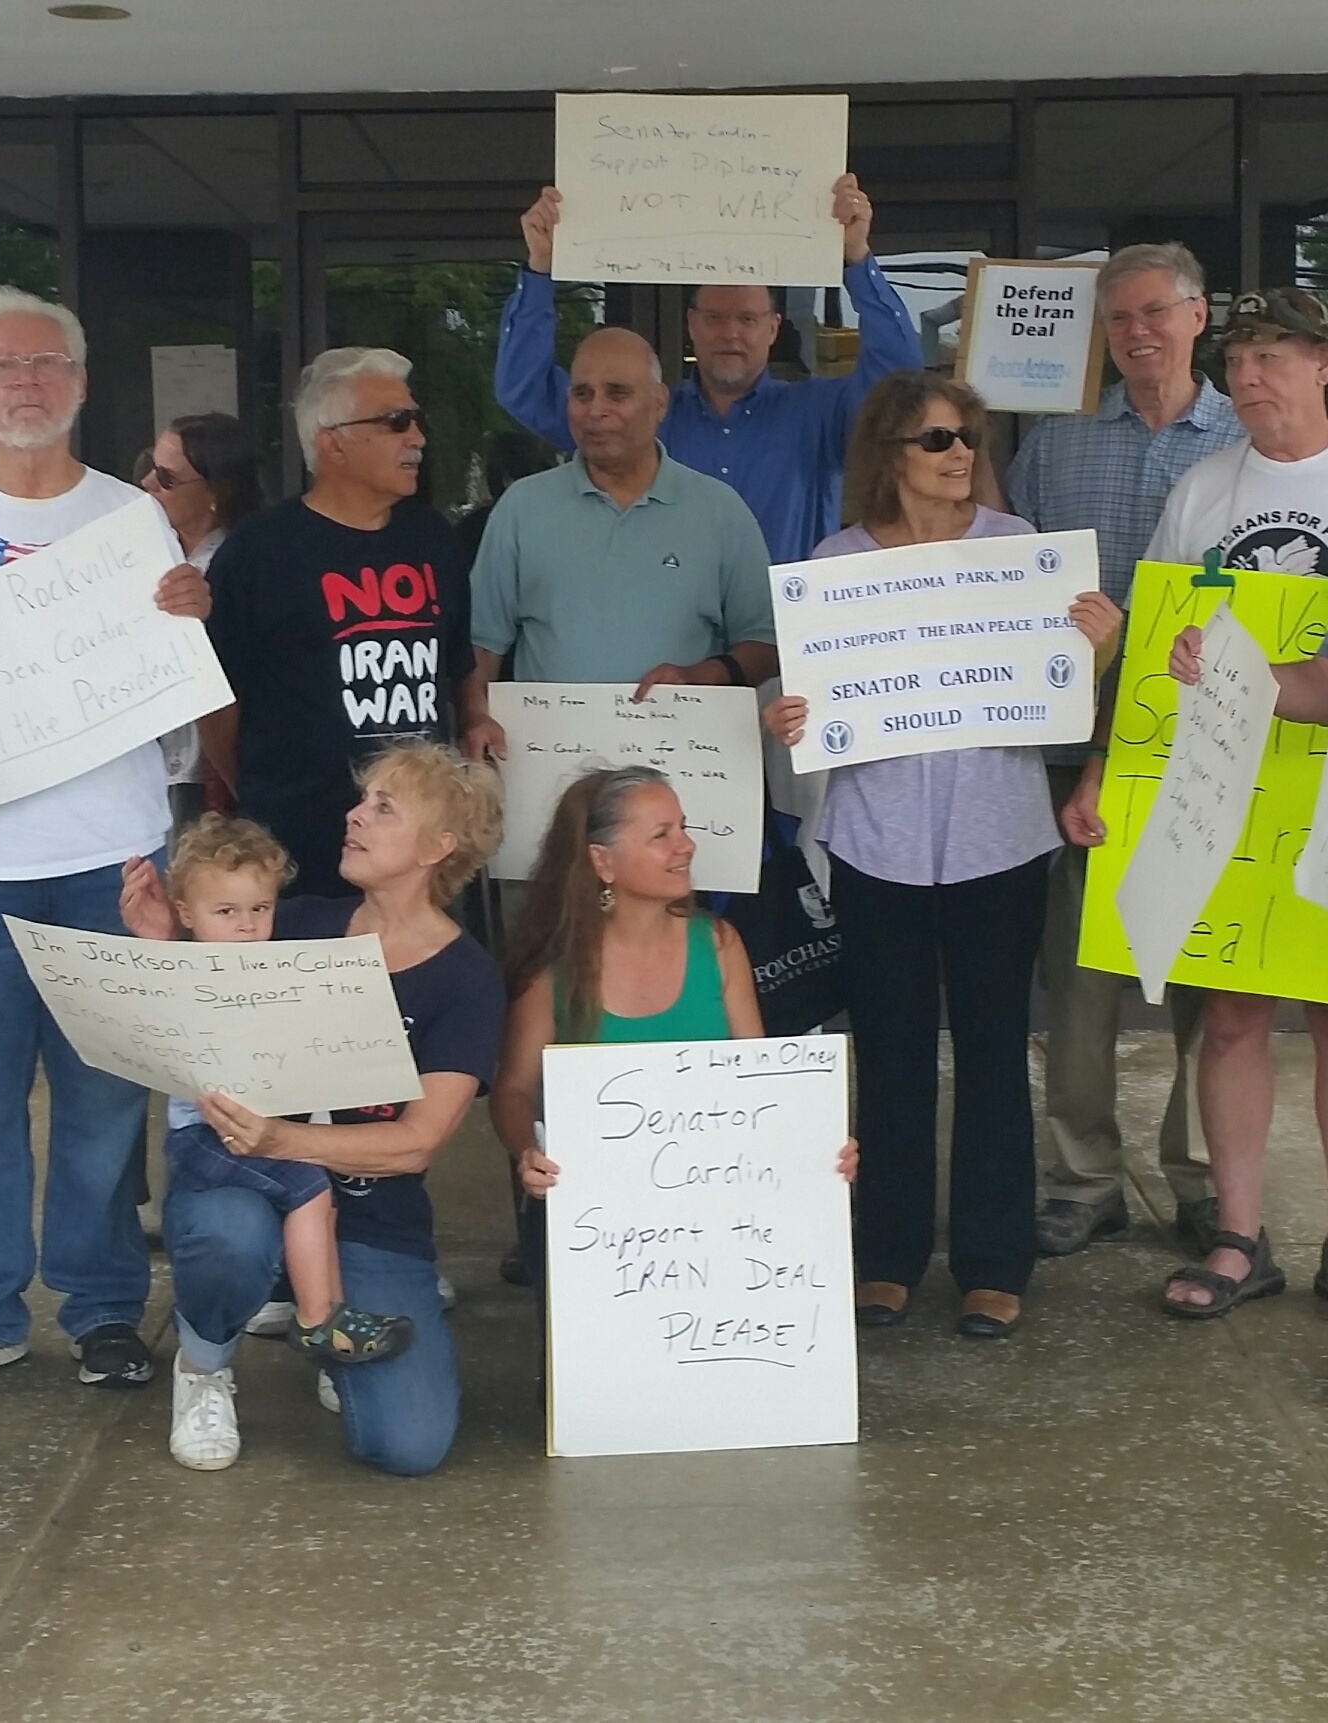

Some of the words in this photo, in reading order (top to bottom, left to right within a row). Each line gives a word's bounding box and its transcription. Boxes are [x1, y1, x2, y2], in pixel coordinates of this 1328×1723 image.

[619, 192, 690, 213] NOT
[1003, 285, 1074, 301] Defend
[996, 303, 1029, 318] the
[1034, 304, 1075, 319] Iran
[1011, 322, 1055, 337] Deal
[1287, 511, 1322, 530] FOR
[5, 540, 135, 615] Rockville
[321, 562, 441, 623] NO!
[823, 590, 830, 602] I
[831, 586, 864, 602] LIVE
[866, 584, 882, 596] IN
[884, 575, 946, 594] TAKOMA
[1001, 569, 1026, 582] MD
[802, 640, 833, 656] AND
[835, 638, 841, 650] I
[843, 628, 907, 650] SUPPORT
[917, 625, 948, 639] THE
[949, 621, 989, 637] IRAN
[989, 618, 1035, 633] PEACE
[339, 637, 439, 685] IRAN
[831, 673, 922, 701] SENATOR
[938, 665, 1014, 687] CARDIN
[341, 681, 439, 730] WAR
[883, 708, 963, 733] SHOULD
[982, 703, 1047, 722] TOO!!!!
[12, 711, 60, 745] the
[26, 929, 66, 955] I'm
[205, 955, 225, 973] I
[240, 955, 269, 971] live
[274, 958, 292, 970] in
[292, 950, 383, 974] Columbia
[193, 983, 306, 1008] Support
[252, 1049, 287, 1070] my
[304, 1035, 399, 1062] future
[675, 1048, 693, 1073] I
[754, 1050, 771, 1065] in
[778, 1042, 838, 1071] Olney
[596, 1068, 780, 1140] Senator
[568, 1206, 704, 1261] Support
[730, 1213, 774, 1244] the
[613, 1257, 710, 1298] IRAN
[744, 1256, 827, 1291] DEAL
